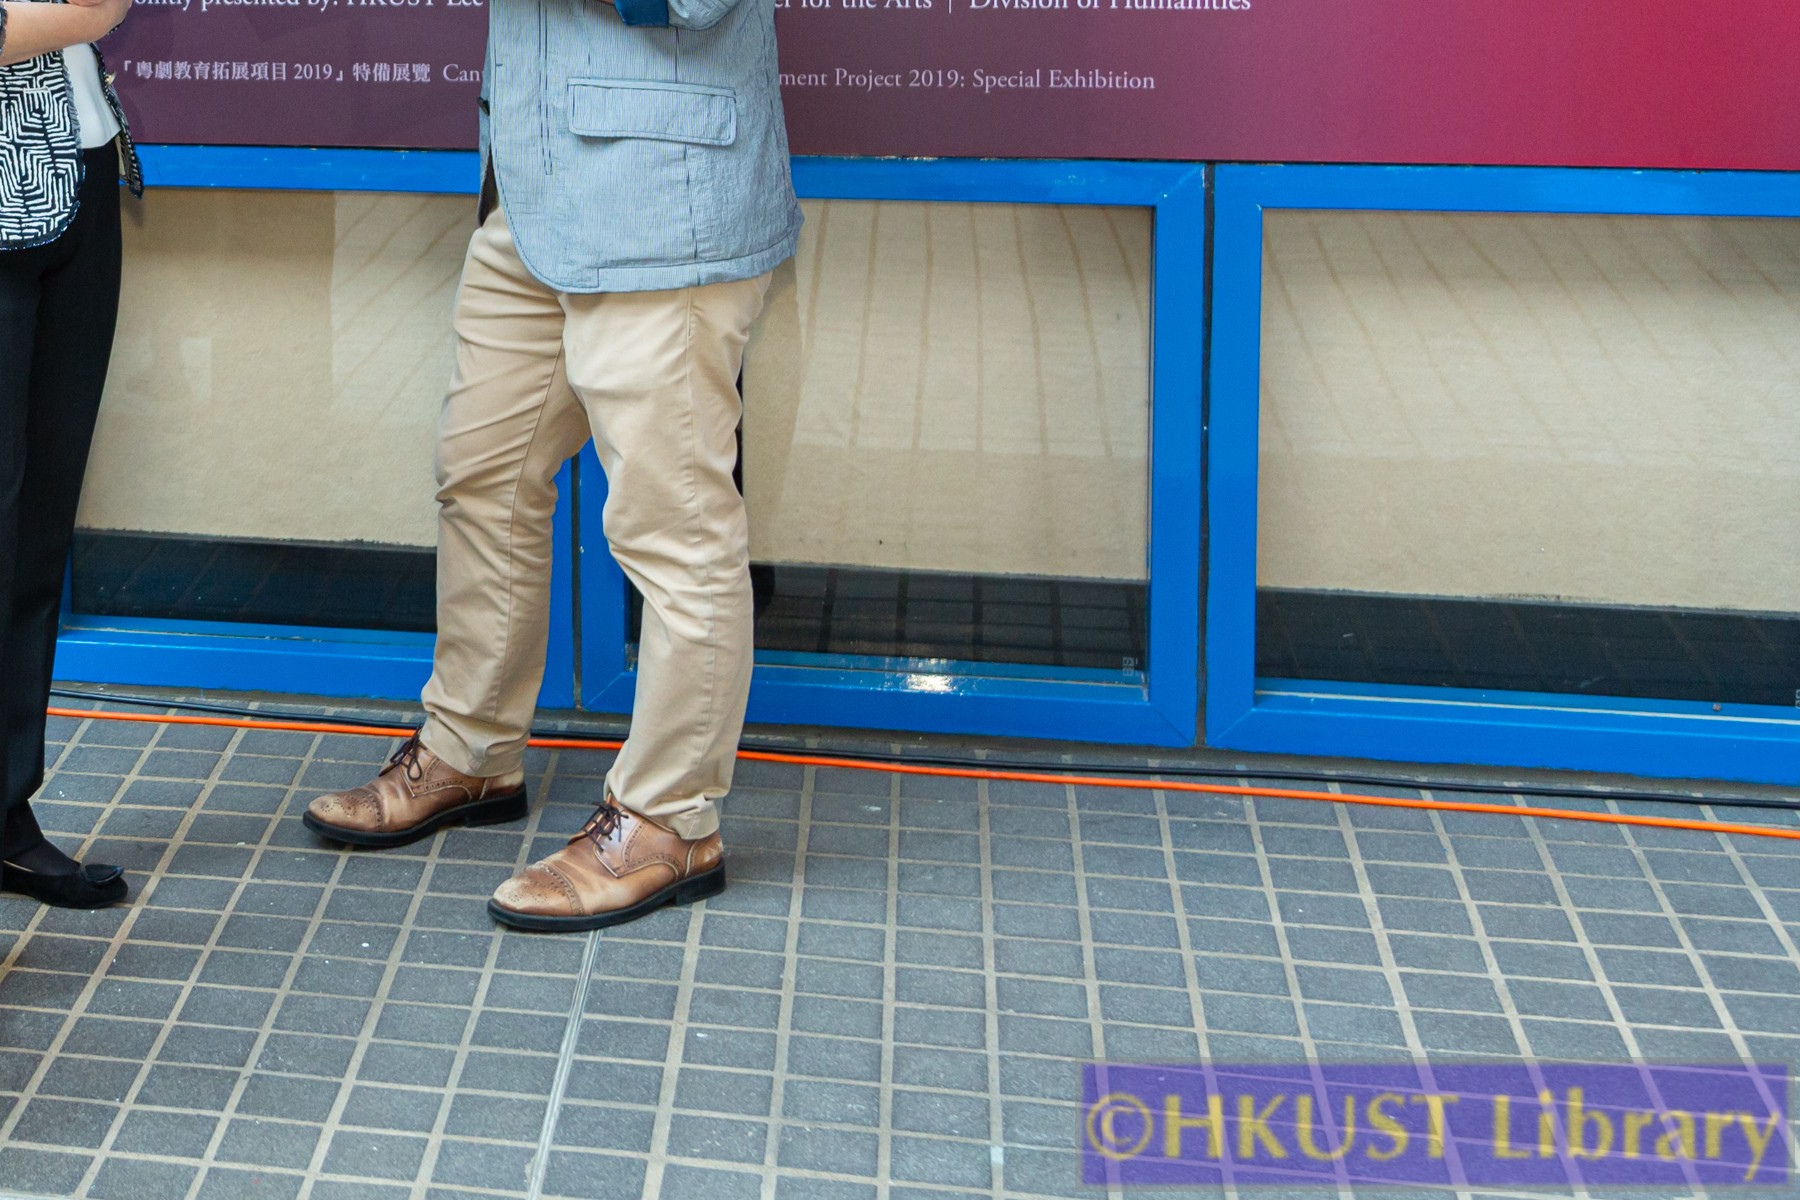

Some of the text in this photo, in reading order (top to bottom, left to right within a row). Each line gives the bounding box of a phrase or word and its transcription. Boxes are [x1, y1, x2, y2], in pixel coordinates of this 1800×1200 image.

[442, 63, 1155, 94] Can ment Project 2019: Special Exhibition
